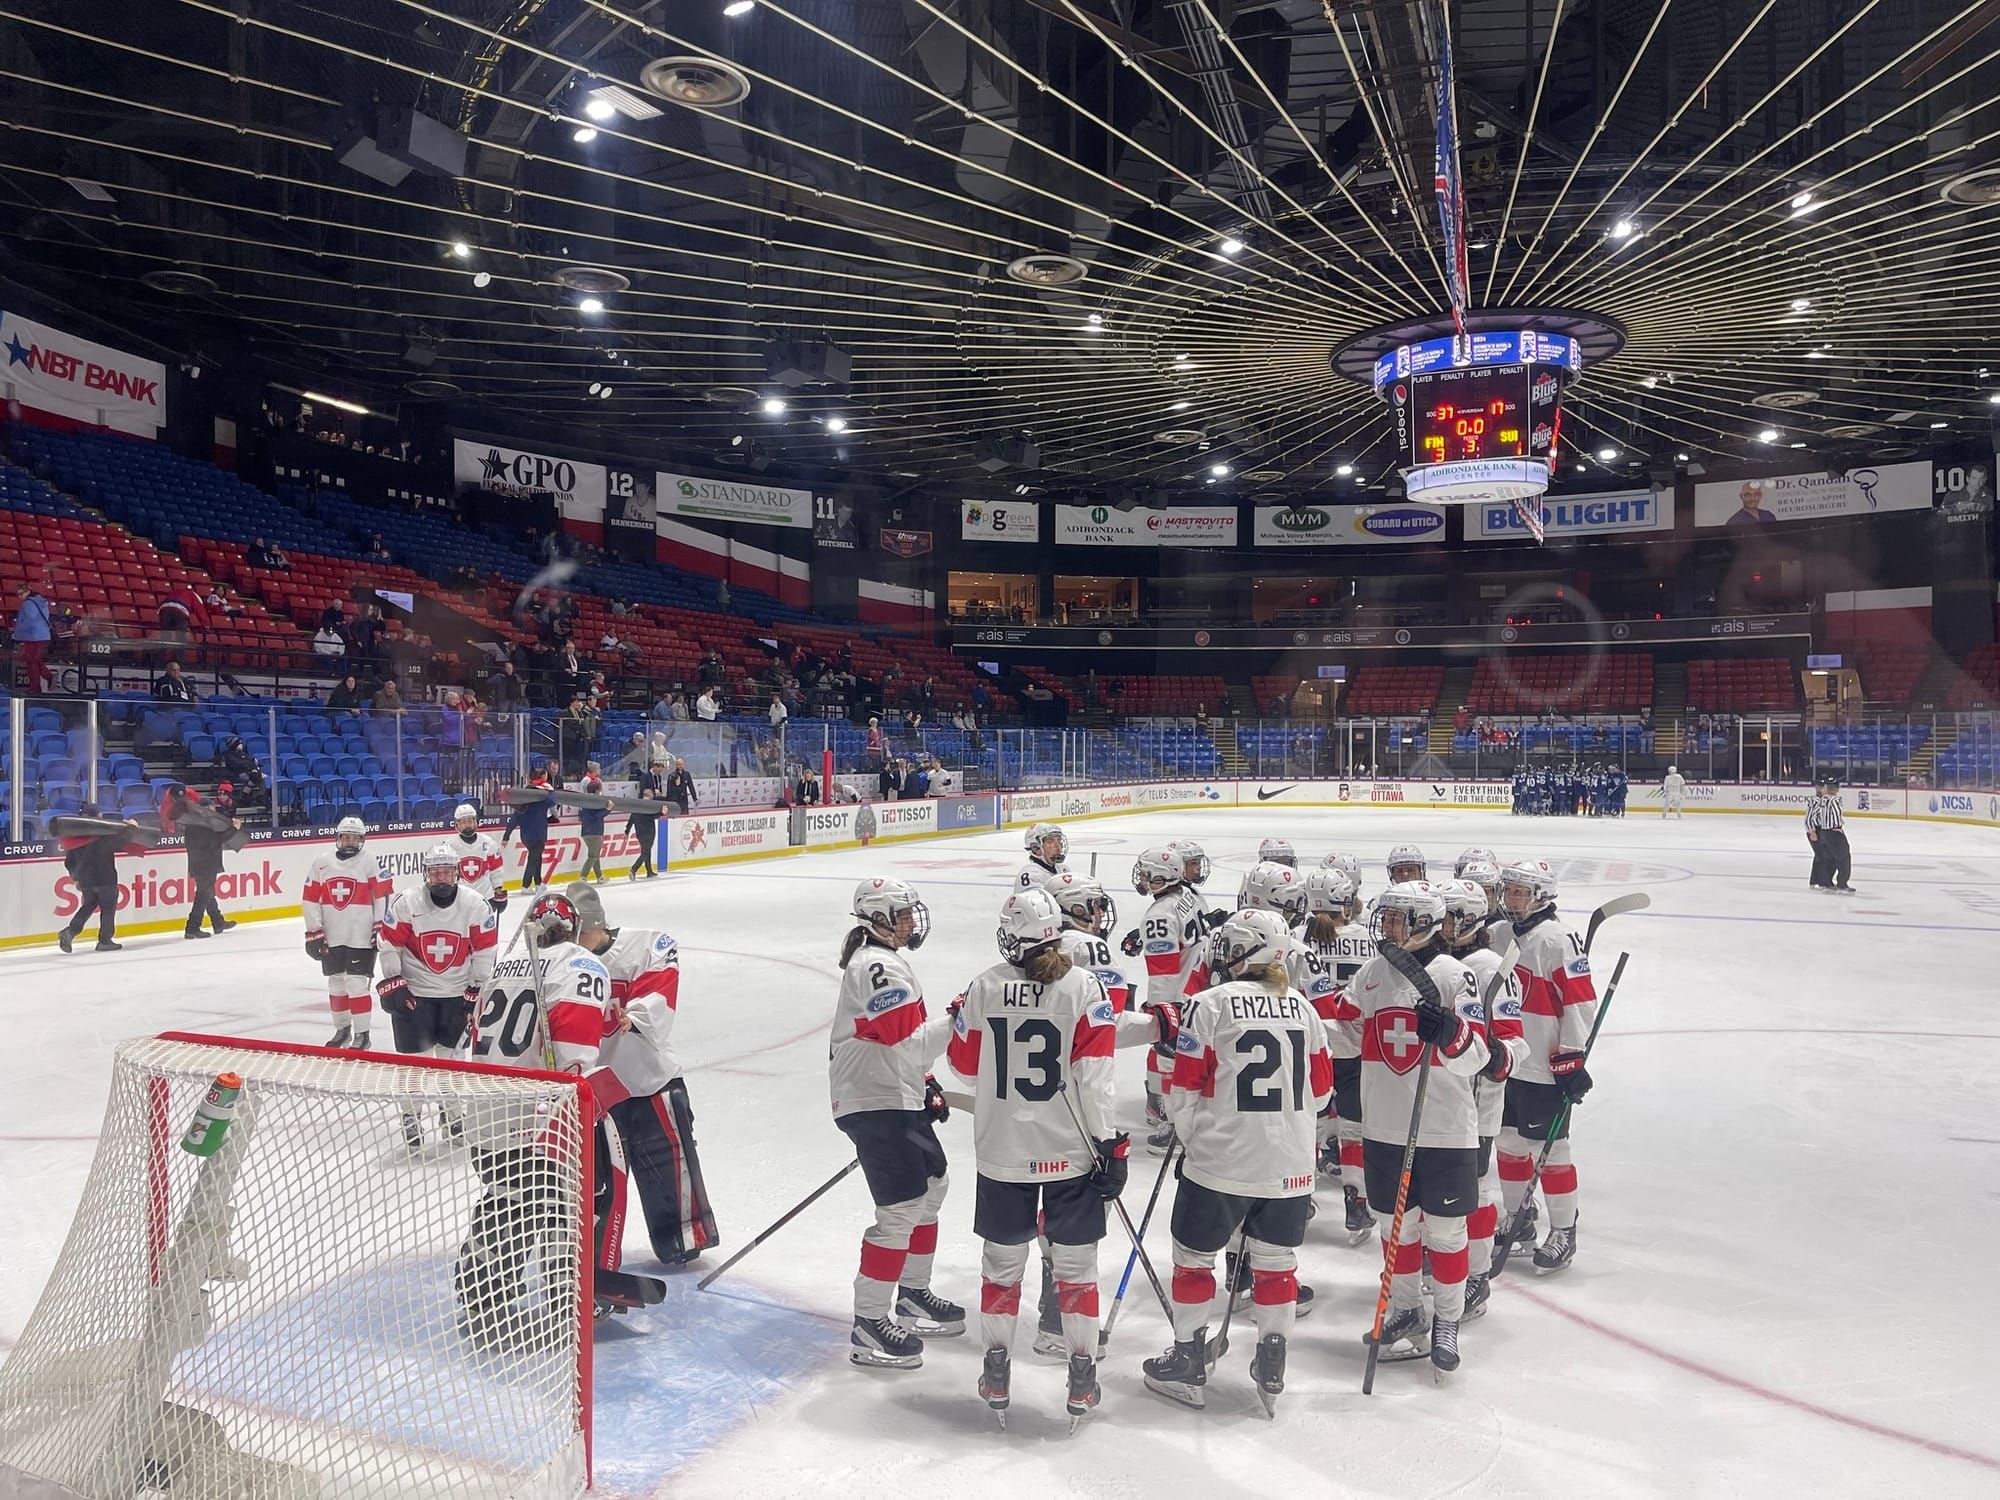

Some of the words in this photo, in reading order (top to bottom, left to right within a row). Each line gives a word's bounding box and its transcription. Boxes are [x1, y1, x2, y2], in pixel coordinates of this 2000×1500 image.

[29, 344, 84, 381] NBT
[85, 363, 158, 406] BANK
[1440, 372, 1464, 381] PENALTY
[1470, 370, 1491, 378] PLAYER
[1499, 366, 1524, 375] PENALTY
[1532, 381, 1557, 402] Blue
[1438, 406, 1454, 420] 37
[1491, 402, 1504, 415] 17
[1396, 407, 1408, 451] pepsi
[1500, 430, 1519, 442] SUI
[1425, 435, 1444, 448] FIN
[1532, 430, 1552, 446] Blue
[1467, 440, 1475, 452] 3
[1434, 448, 1445, 463] 3
[512, 454, 576, 492] GPO
[1431, 464, 1490, 477] ADIRONDACK
[1492, 462, 1518, 471] BANK
[1455, 471, 1491, 480] CENTER
[609, 471, 634, 498] 12
[1775, 480, 1796, 489] Dr.
[1935, 466, 1965, 493] 10
[700, 484, 792, 507] STANDARD
[816, 496, 836, 519] 11
[1557, 500, 1649, 526] LIGHT
[1166, 517, 1234, 525] MASTROVITO
[1281, 513, 1322, 525] MVM
[1366, 518, 1400, 529] SUBARU
[1402, 520, 1411, 528] of
[1412, 516, 1438, 527] UTICA
[1946, 513, 1979, 523] SMITH
[1065, 525, 1135, 535] ADIRONDACK
[818, 540, 854, 549] MITCHELL
[1085, 535, 1115, 543] BANK
[1723, 619, 1745, 632] ais
[986, 630, 1004, 641] ais
[1333, 630, 1351, 642] ais
[91, 644, 111, 654] 102
[1149, 789, 1168, 800] TELUS
[1371, 791, 1404, 802] OTTAWA
[1453, 785, 1509, 795] EVERYTHING
[1100, 793, 1132, 808] Scotiabank
[1454, 795, 1468, 803] FOR
[1471, 795, 1484, 803] THE
[1487, 795, 1509, 804] GIRLS
[1941, 796, 1973, 811] NCSA
[966, 804, 977, 816] BFL
[1061, 800, 1090, 816] LiveBarn
[807, 813, 849, 831] TISSOT
[898, 806, 931, 822] TISSOT
[707, 821, 718, 834] MAY
[732, 819, 745, 832] 2024
[721, 833, 763, 848] HOCKEYCANADA.CA
[1021, 872, 1030, 886] 8
[1043, 927, 1053, 938] 13
[1146, 919, 1168, 939] 25
[1085, 941, 1111, 965] 18
[1149, 943, 1169, 952] Ford
[1274, 950, 1283, 960] 21
[869, 962, 888, 990] 2
[576, 972, 604, 1001] 20
[1463, 971, 1478, 998] 9
[873, 993, 901, 1012] Ford
[1004, 983, 1044, 1008] WEY
[1231, 996, 1302, 1020] ENZLER
[473, 988, 539, 1057] 20
[987, 1017, 1062, 1101] 13
[1235, 1029, 1305, 1112] 21
[1039, 1160, 1069, 1173] IIHF
[1290, 1174, 1312, 1189] IIHF
